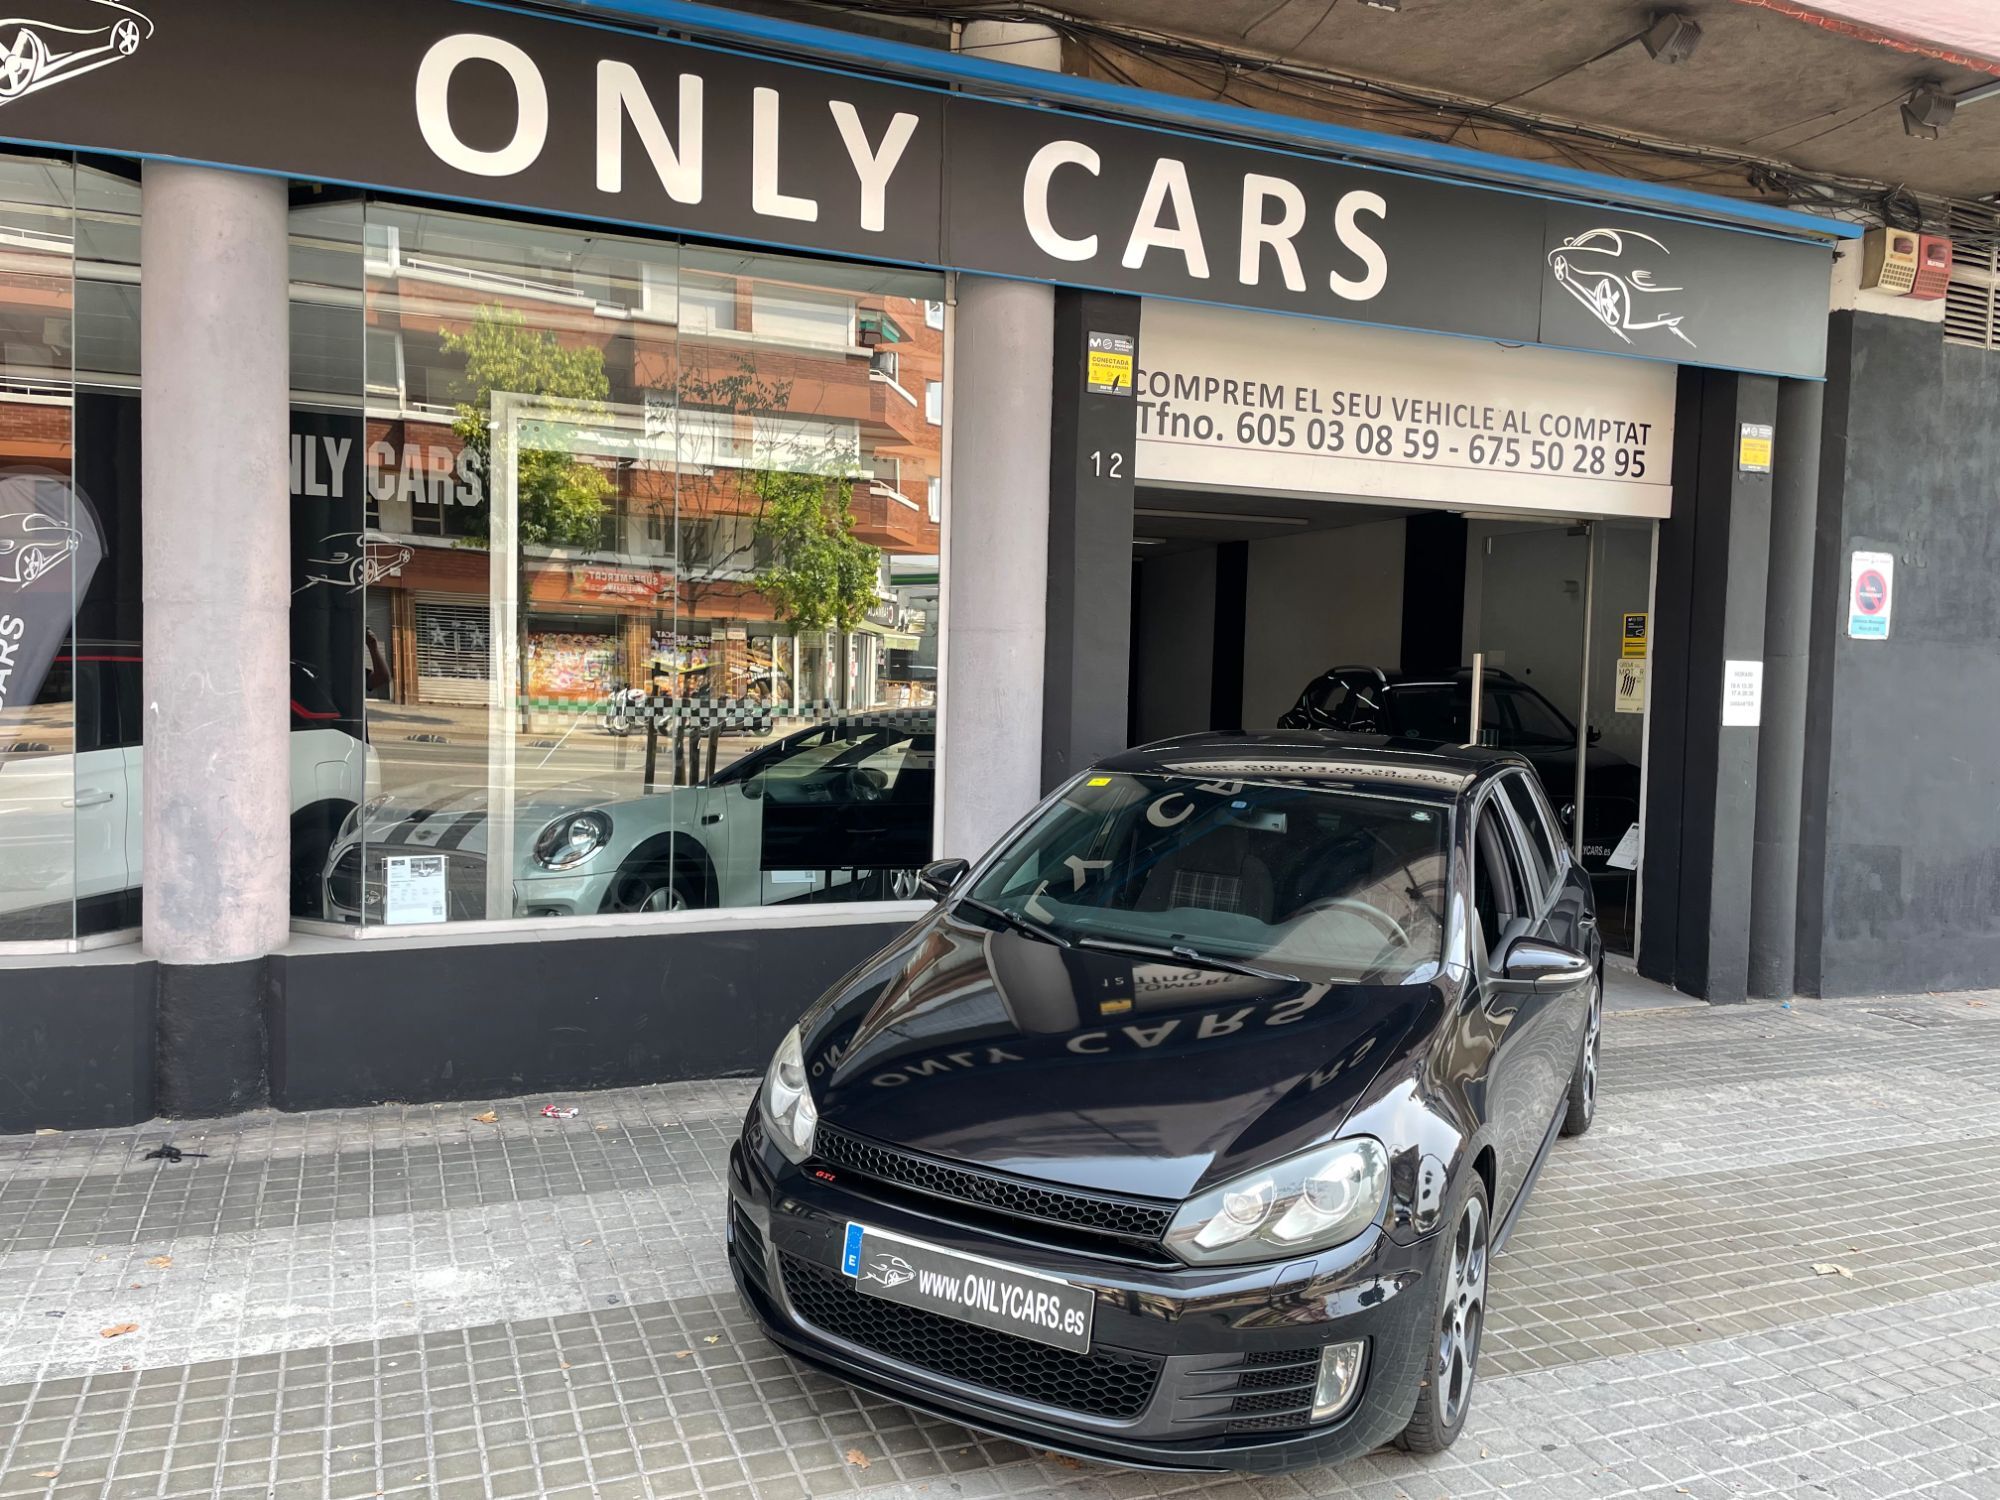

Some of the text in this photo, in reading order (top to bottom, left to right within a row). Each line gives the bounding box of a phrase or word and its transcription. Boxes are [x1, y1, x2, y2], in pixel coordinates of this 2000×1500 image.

[415, 33, 1388, 301] ONLY CARS
[1091, 356, 1129, 366] CONECTADA
[1136, 369, 1652, 446] COMPREM EL SEU VEHICLE AL COMPTAT
[1136, 401, 1223, 441] Tfno.
[1236, 411, 1296, 447] 605
[1307, 418, 1345, 451] 03
[1355, 423, 1393, 456] 08
[1403, 428, 1440, 460] 59
[1468, 434, 1521, 468] 675
[1530, 440, 1564, 471] 50
[1572, 444, 1606, 475] 28
[1614, 448, 1646, 478] 95
[368, 441, 484, 507] CARS
[1090, 451, 1123, 478] 12
[0, 614, 25, 713] ARS
[815, 1169, 836, 1183] GTI
[848, 1254, 857, 1267] E
[918, 1268, 1085, 1336] www.ONLYCARS.es
